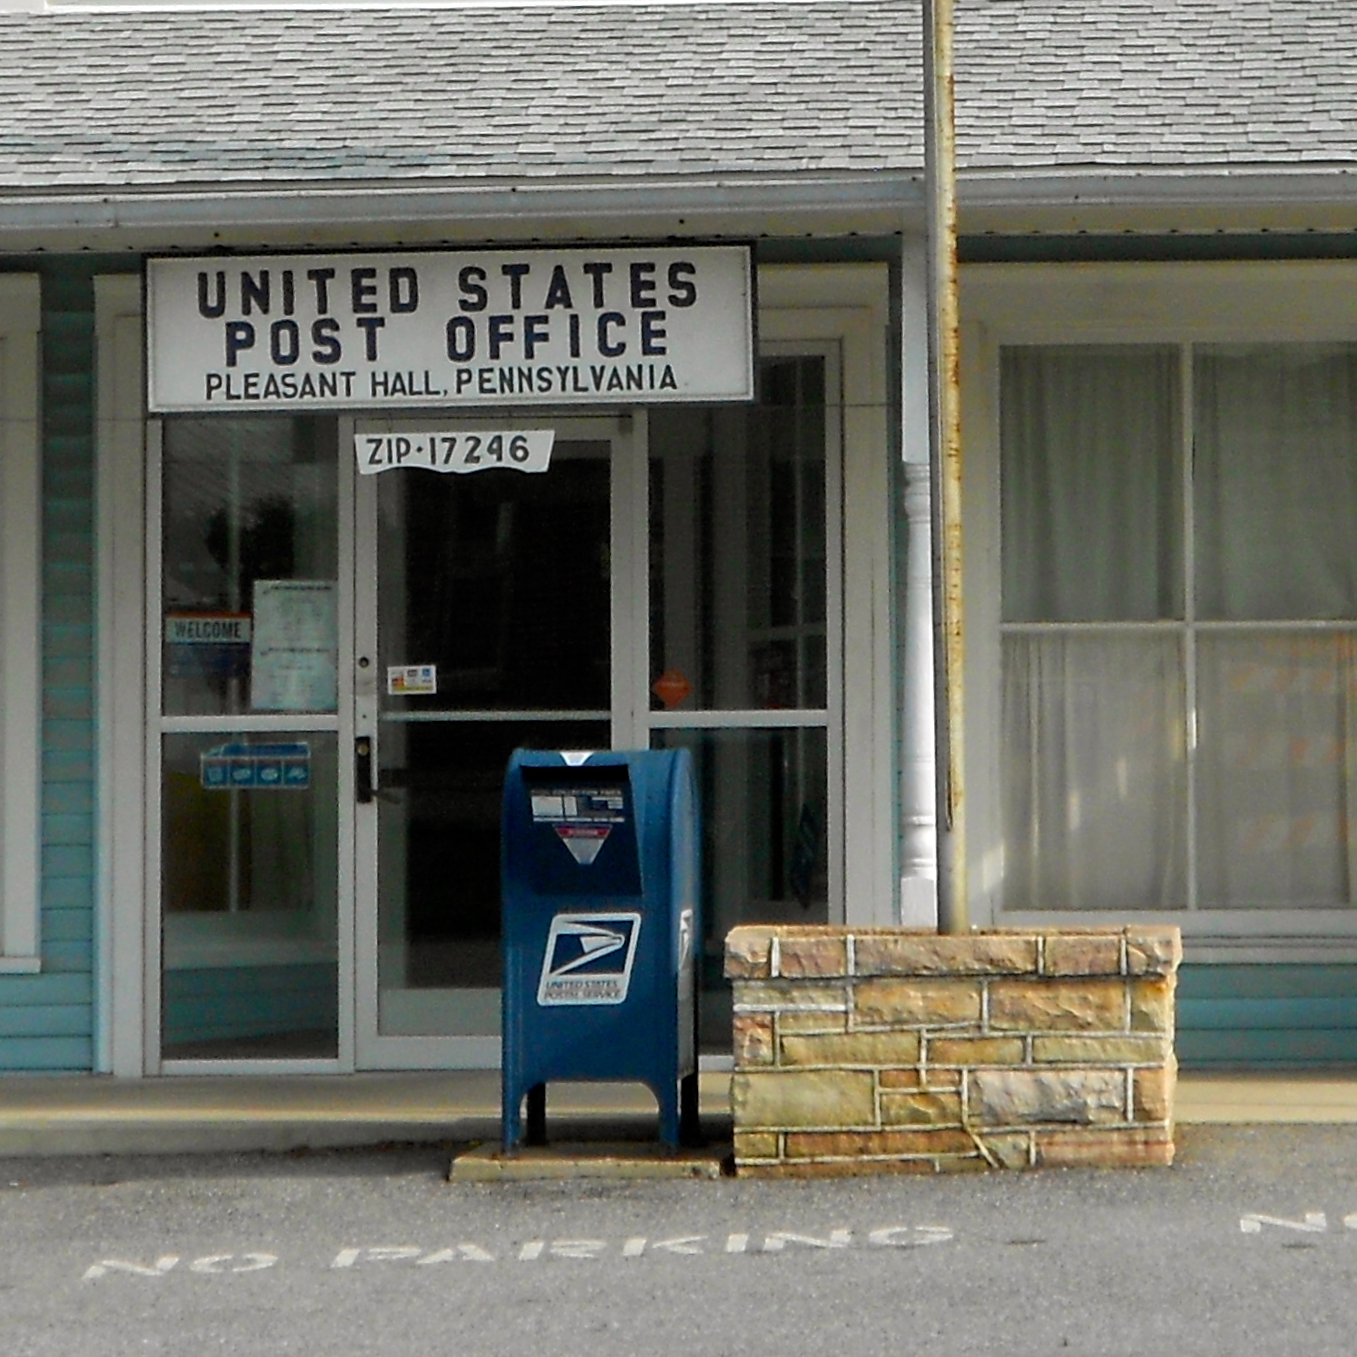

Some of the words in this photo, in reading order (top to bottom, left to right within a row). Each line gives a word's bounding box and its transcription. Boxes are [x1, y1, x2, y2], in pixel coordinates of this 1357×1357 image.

[197, 267, 420, 318] UNITED
[457, 261, 698, 312] STATES
[225, 317, 386, 368] POST
[446, 311, 669, 363] OFFICE
[205, 370, 357, 401] PLEASANT
[371, 367, 449, 397] HALL,
[455, 364, 679, 395] PENNSYLVANIA
[175, 621, 242, 639] WELCOME
[81, 1252, 279, 1281] NO
[330, 1225, 955, 1269] PARKING
